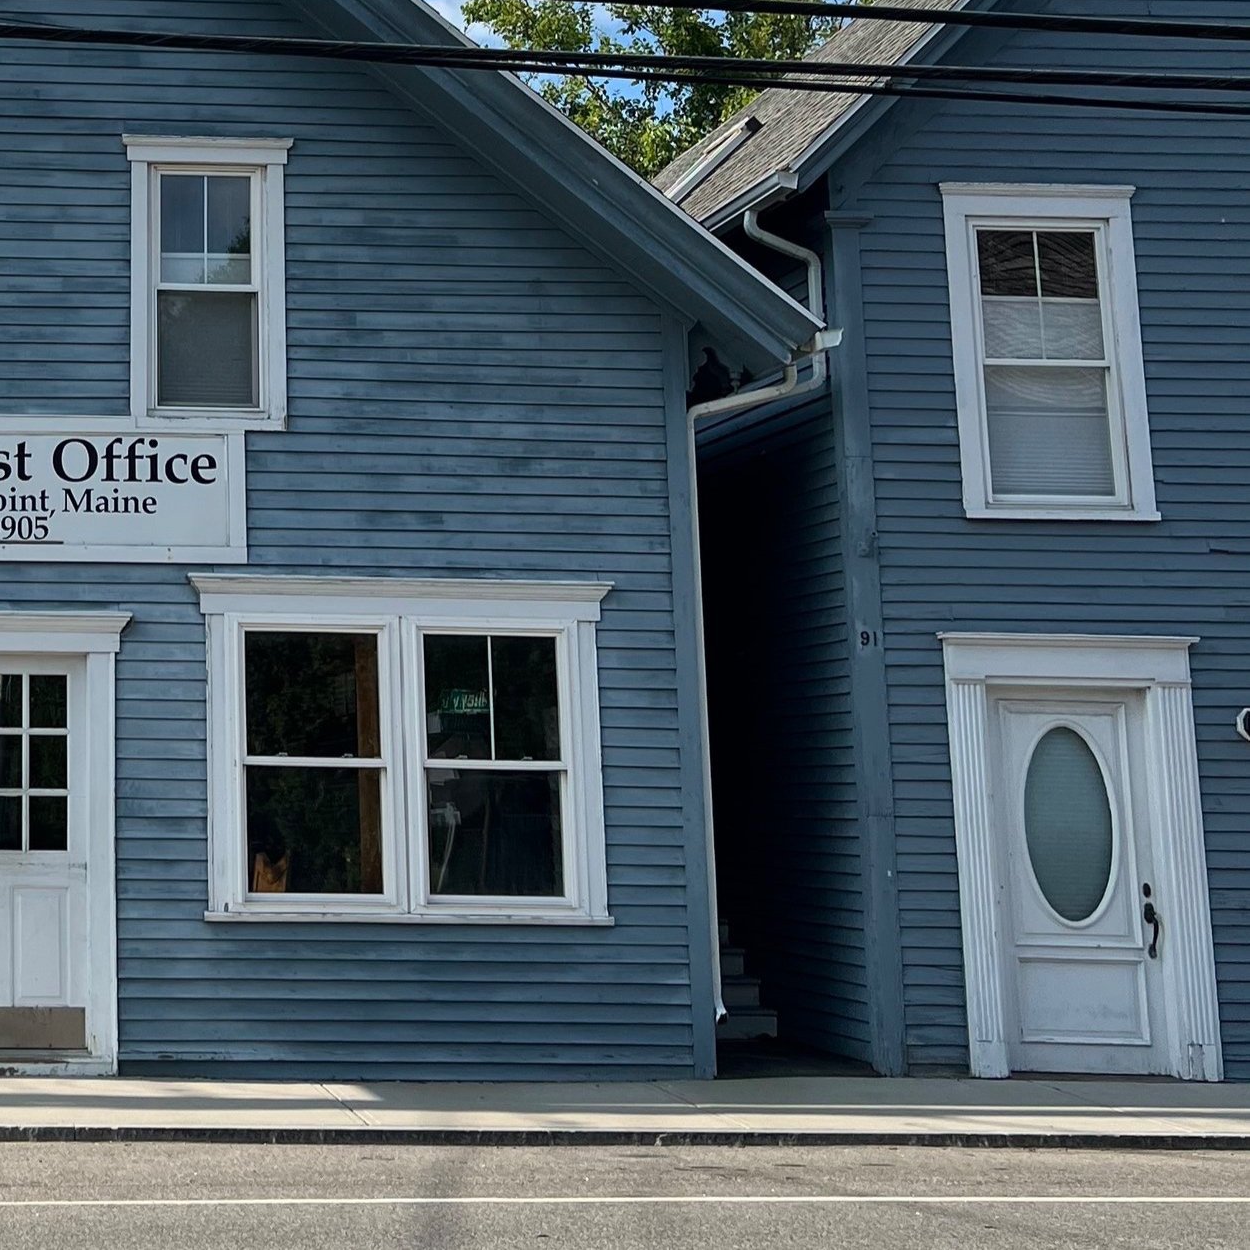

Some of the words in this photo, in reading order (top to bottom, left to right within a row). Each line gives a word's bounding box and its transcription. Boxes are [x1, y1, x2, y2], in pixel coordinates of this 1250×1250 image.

[52, 437, 217, 485] Office
[62, 488, 158, 515] Maine
[860, 630, 877, 647] 91
